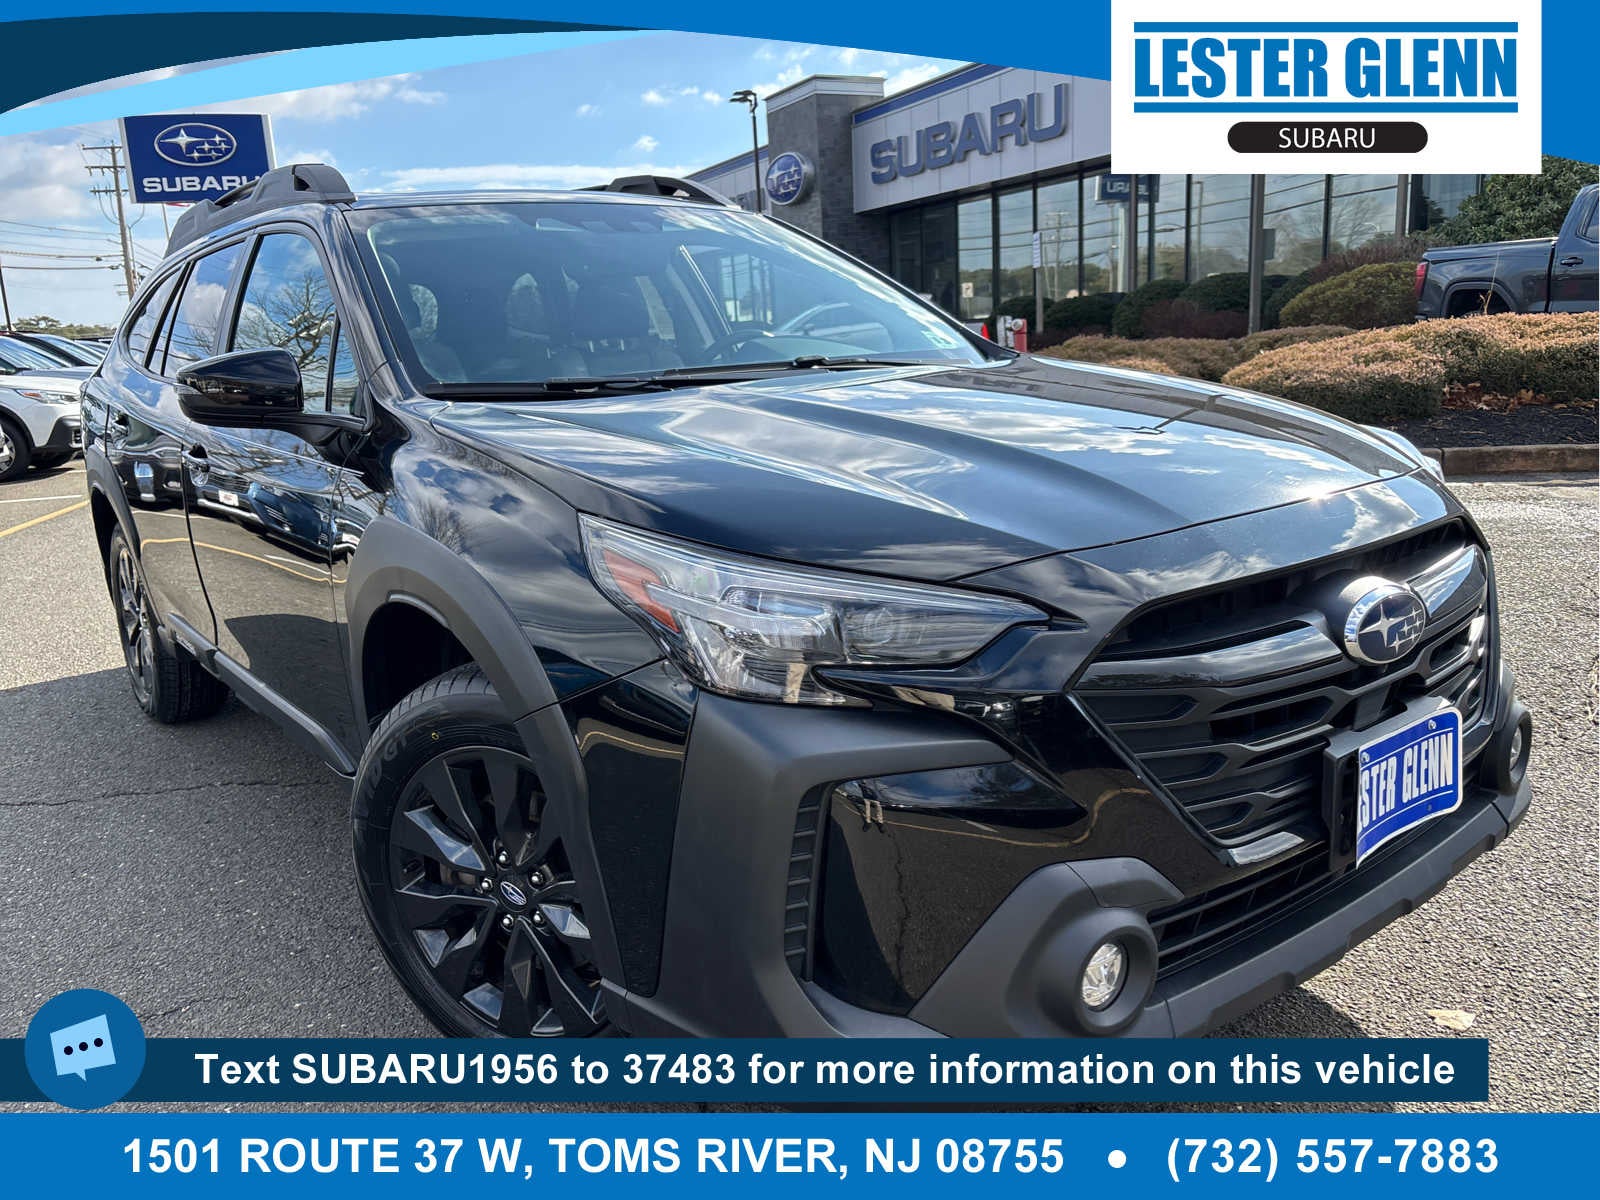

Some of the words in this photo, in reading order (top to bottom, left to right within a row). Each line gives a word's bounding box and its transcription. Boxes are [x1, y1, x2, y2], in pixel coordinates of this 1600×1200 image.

[871, 83, 1070, 185] SUBARU
[1359, 756, 1397, 830] STER
[1402, 732, 1453, 804] GLENN
